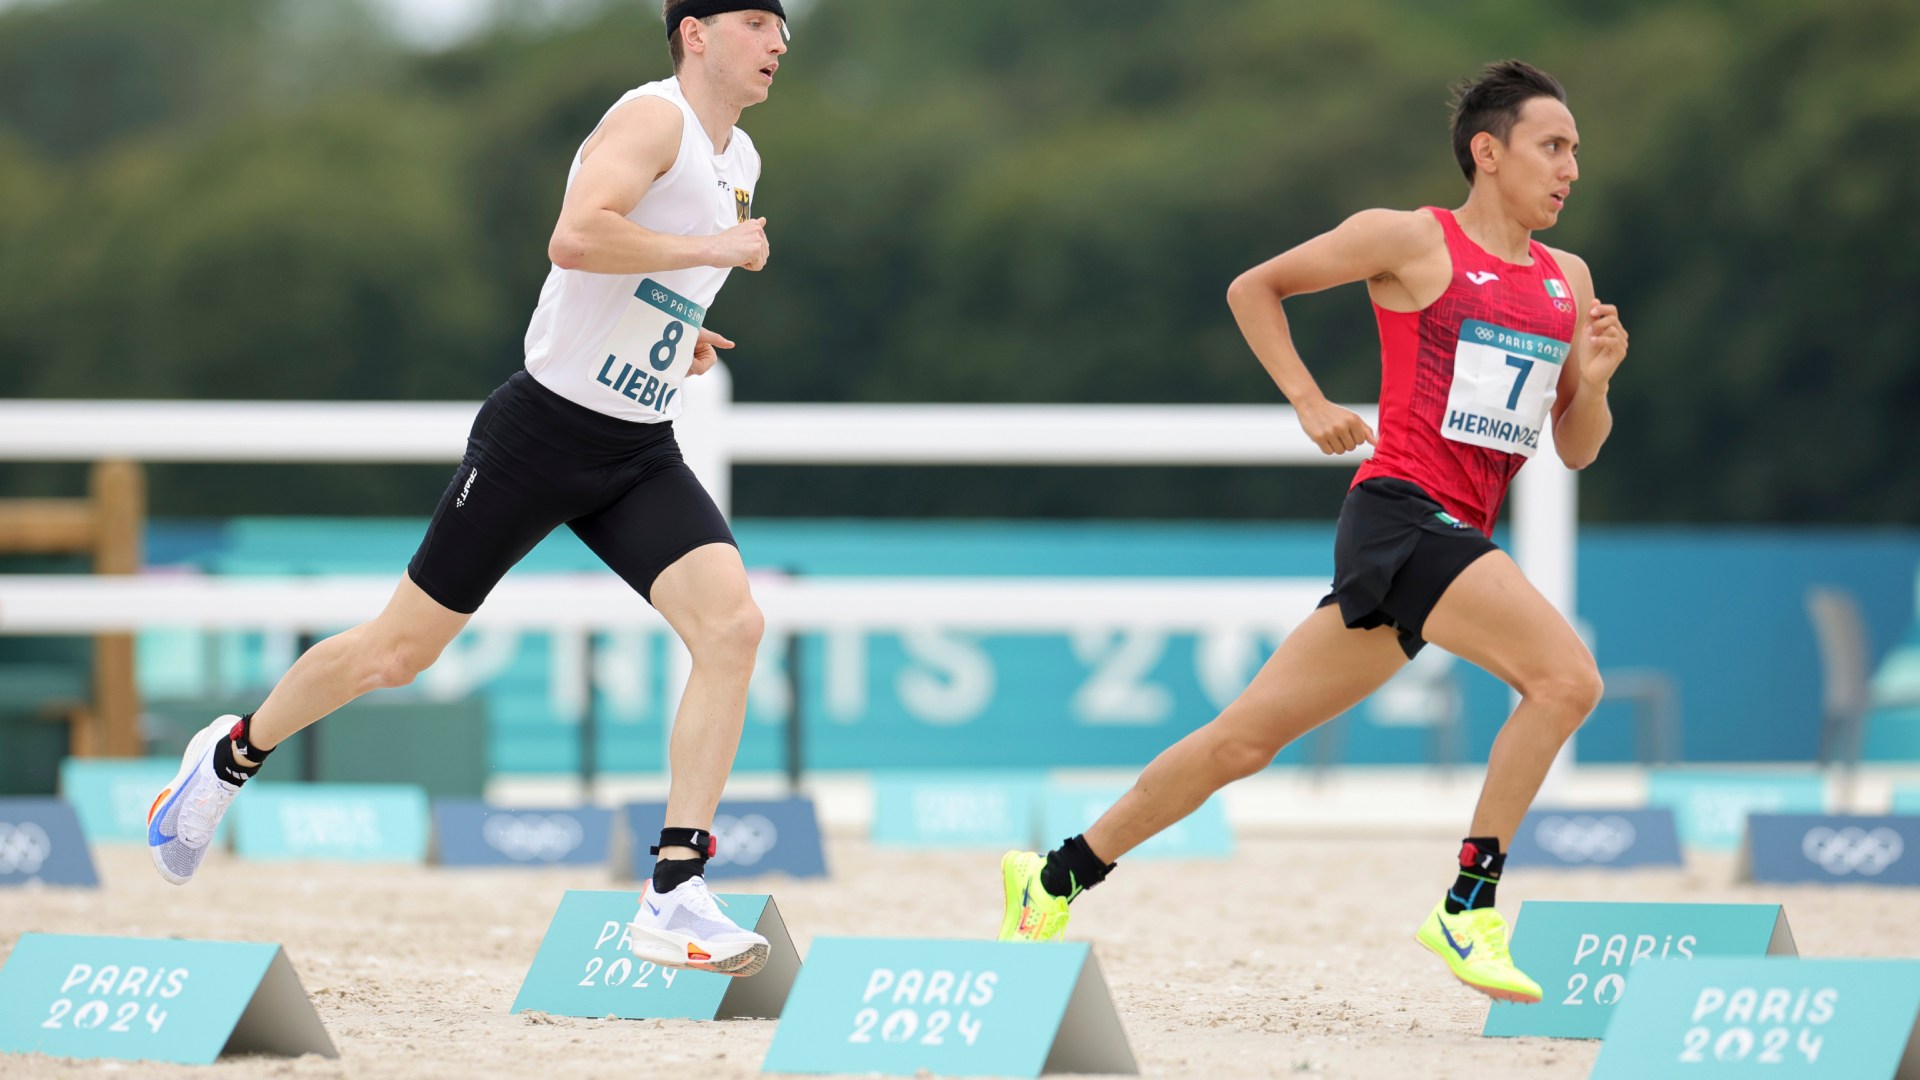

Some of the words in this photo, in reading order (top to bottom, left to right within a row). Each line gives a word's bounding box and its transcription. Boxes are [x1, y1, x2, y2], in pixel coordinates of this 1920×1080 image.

[649, 320, 684, 372] 8
[1505, 354, 1535, 411] 7
[460, 467, 478, 501] CRAFT
[577, 956, 678, 989] 2024
[1561, 972, 1626, 1006] 20
[40, 998, 169, 1034] 2024
[847, 1006, 983, 1047] 2024
[1677, 1025, 1824, 1065] 2024
